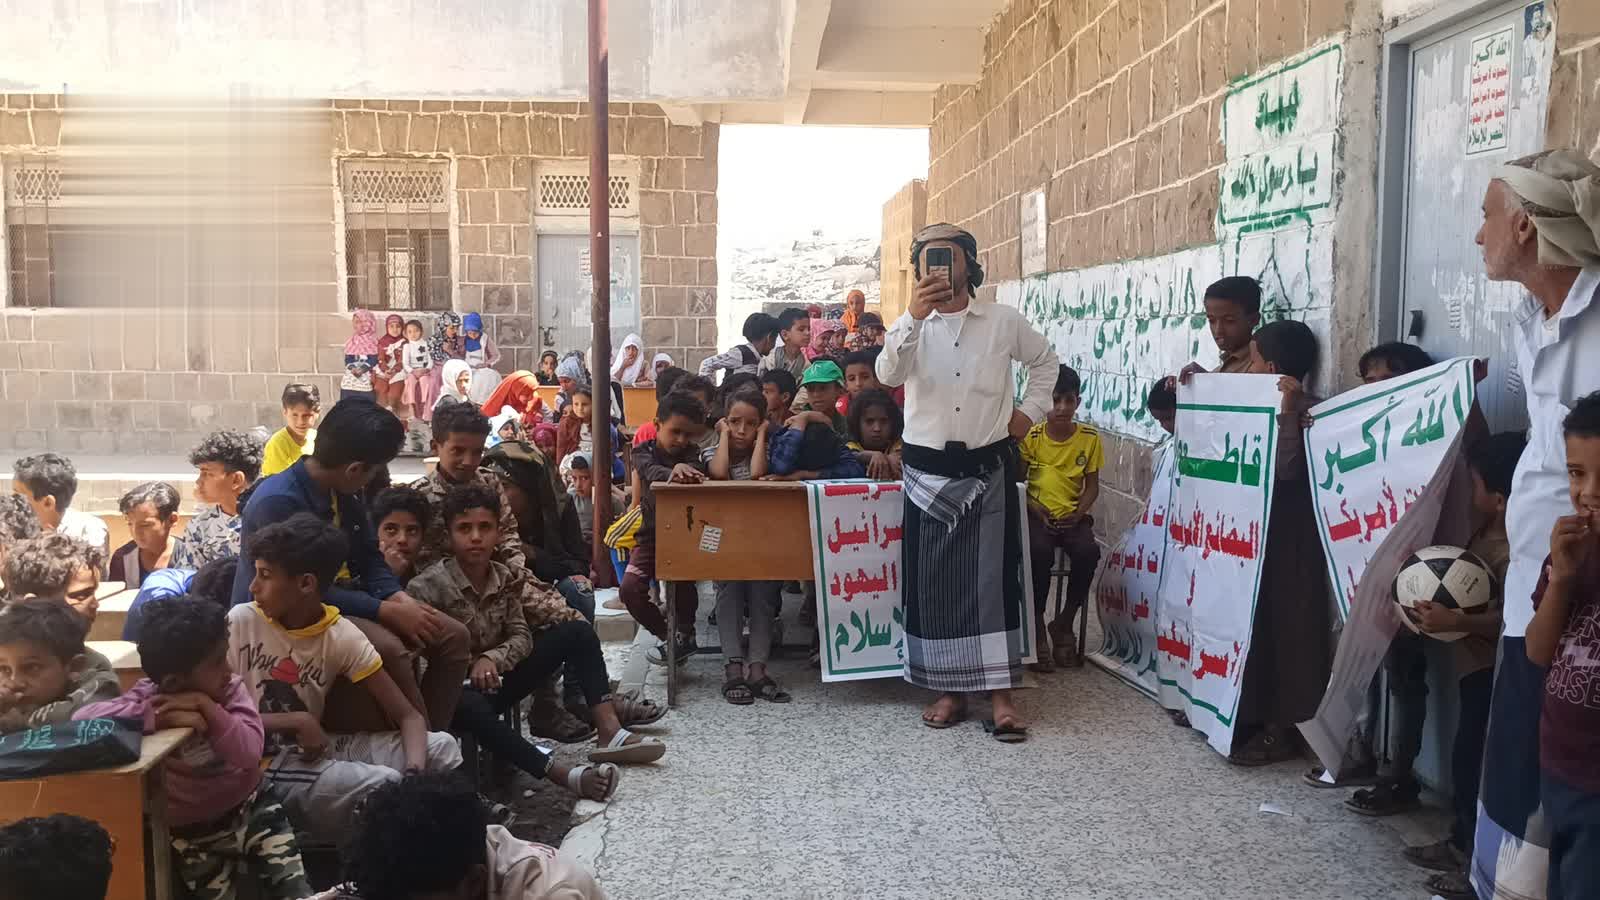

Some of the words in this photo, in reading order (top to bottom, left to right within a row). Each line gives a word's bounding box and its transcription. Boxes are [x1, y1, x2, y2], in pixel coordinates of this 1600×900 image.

[1401, 379, 1465, 447] الله
[1318, 395, 1406, 495] أكبر
[827, 511, 904, 554] سرائيل
[830, 560, 898, 602] اليهود
